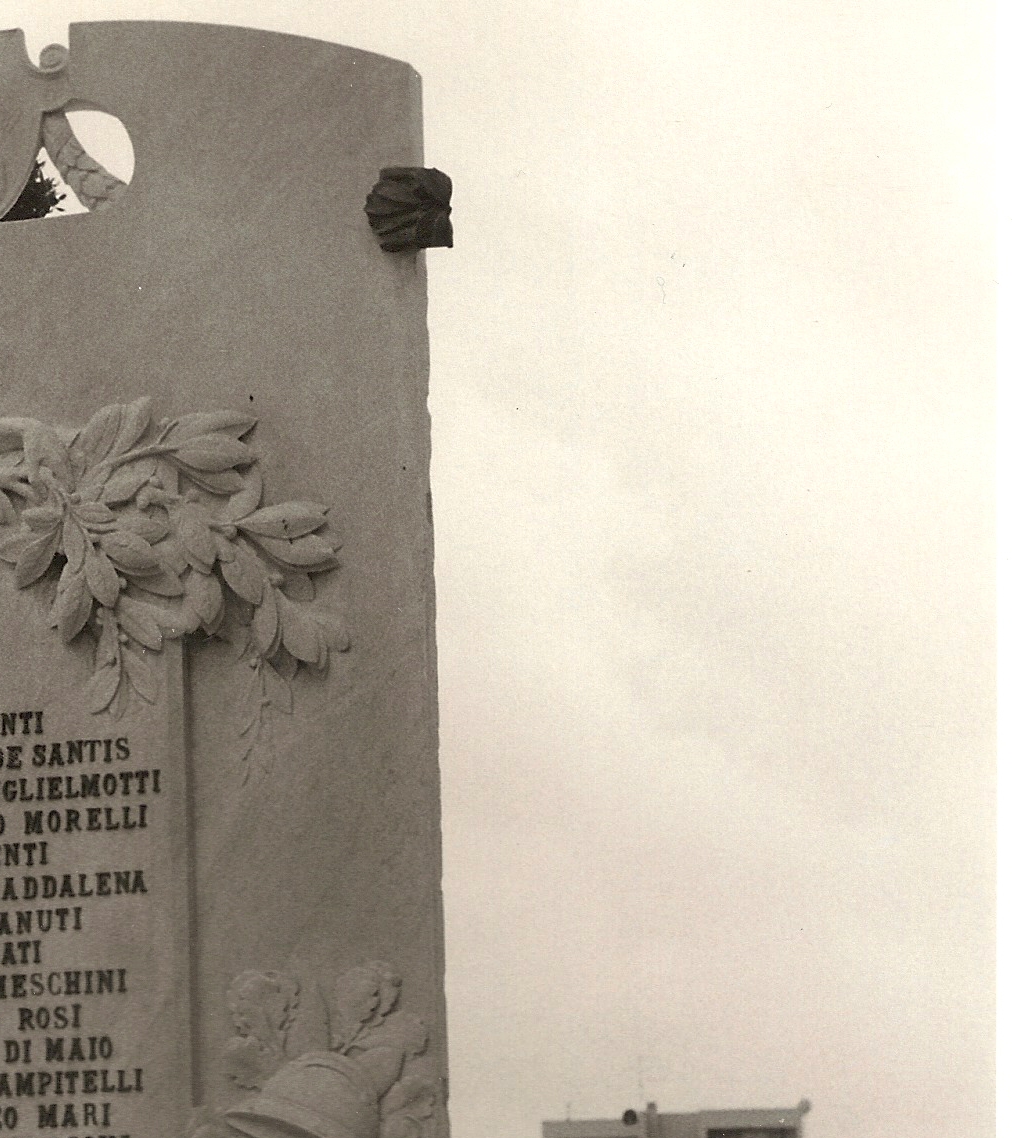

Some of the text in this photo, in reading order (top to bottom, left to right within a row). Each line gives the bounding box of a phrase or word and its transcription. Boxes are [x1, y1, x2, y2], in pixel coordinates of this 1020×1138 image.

[32, 738, 130, 767] SANTIS
[24, 805, 148, 835] MORELLI
[18, 1004, 82, 1031] ROSI
[5, 1040, 31, 1064] DI
[45, 1036, 113, 1062] MAIO
[38, 1102, 111, 1128] MARI
